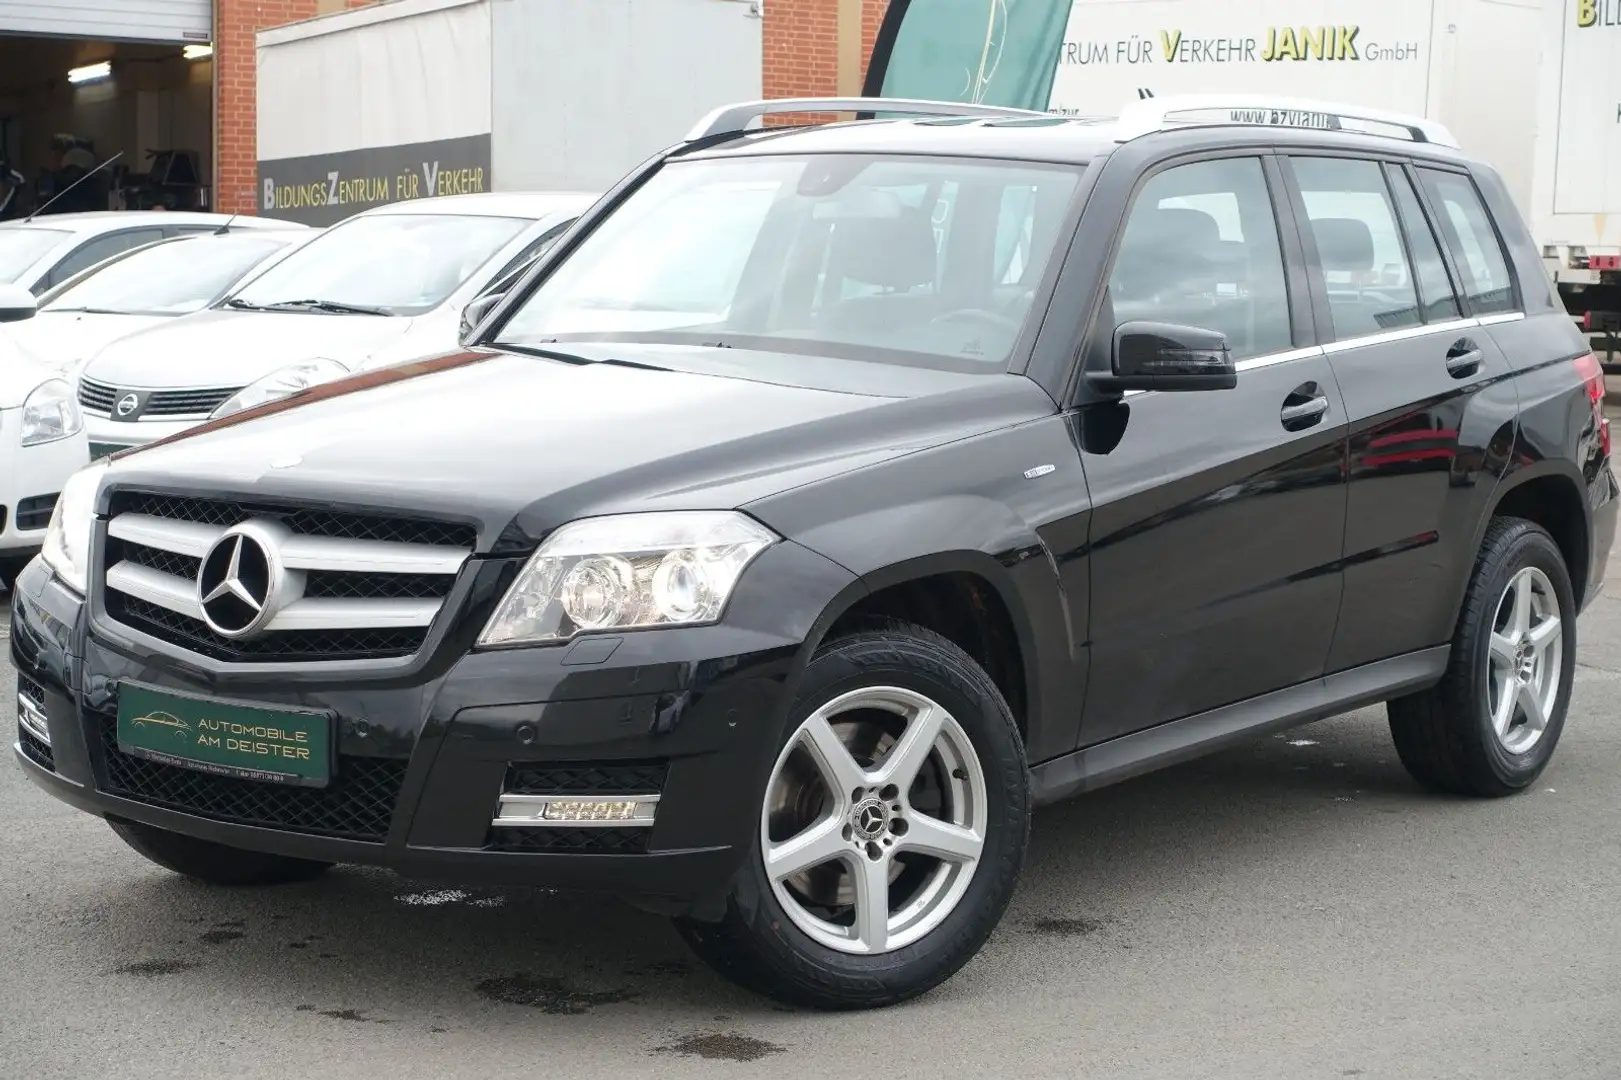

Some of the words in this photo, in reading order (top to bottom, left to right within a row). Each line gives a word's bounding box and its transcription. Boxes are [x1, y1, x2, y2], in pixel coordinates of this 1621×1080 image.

[1116, 35, 1153, 64] FÜR
[1160, 29, 1257, 63] VERKEHR
[1261, 25, 1360, 62] JANIK
[1365, 42, 1418, 62] GmbH
[396, 167, 419, 199] FÜR
[422, 160, 484, 197] VERKEHR
[198, 718, 308, 743] AUTOMOBILE
[197, 734, 221, 748] AM
[226, 738, 310, 761] DEISTER
